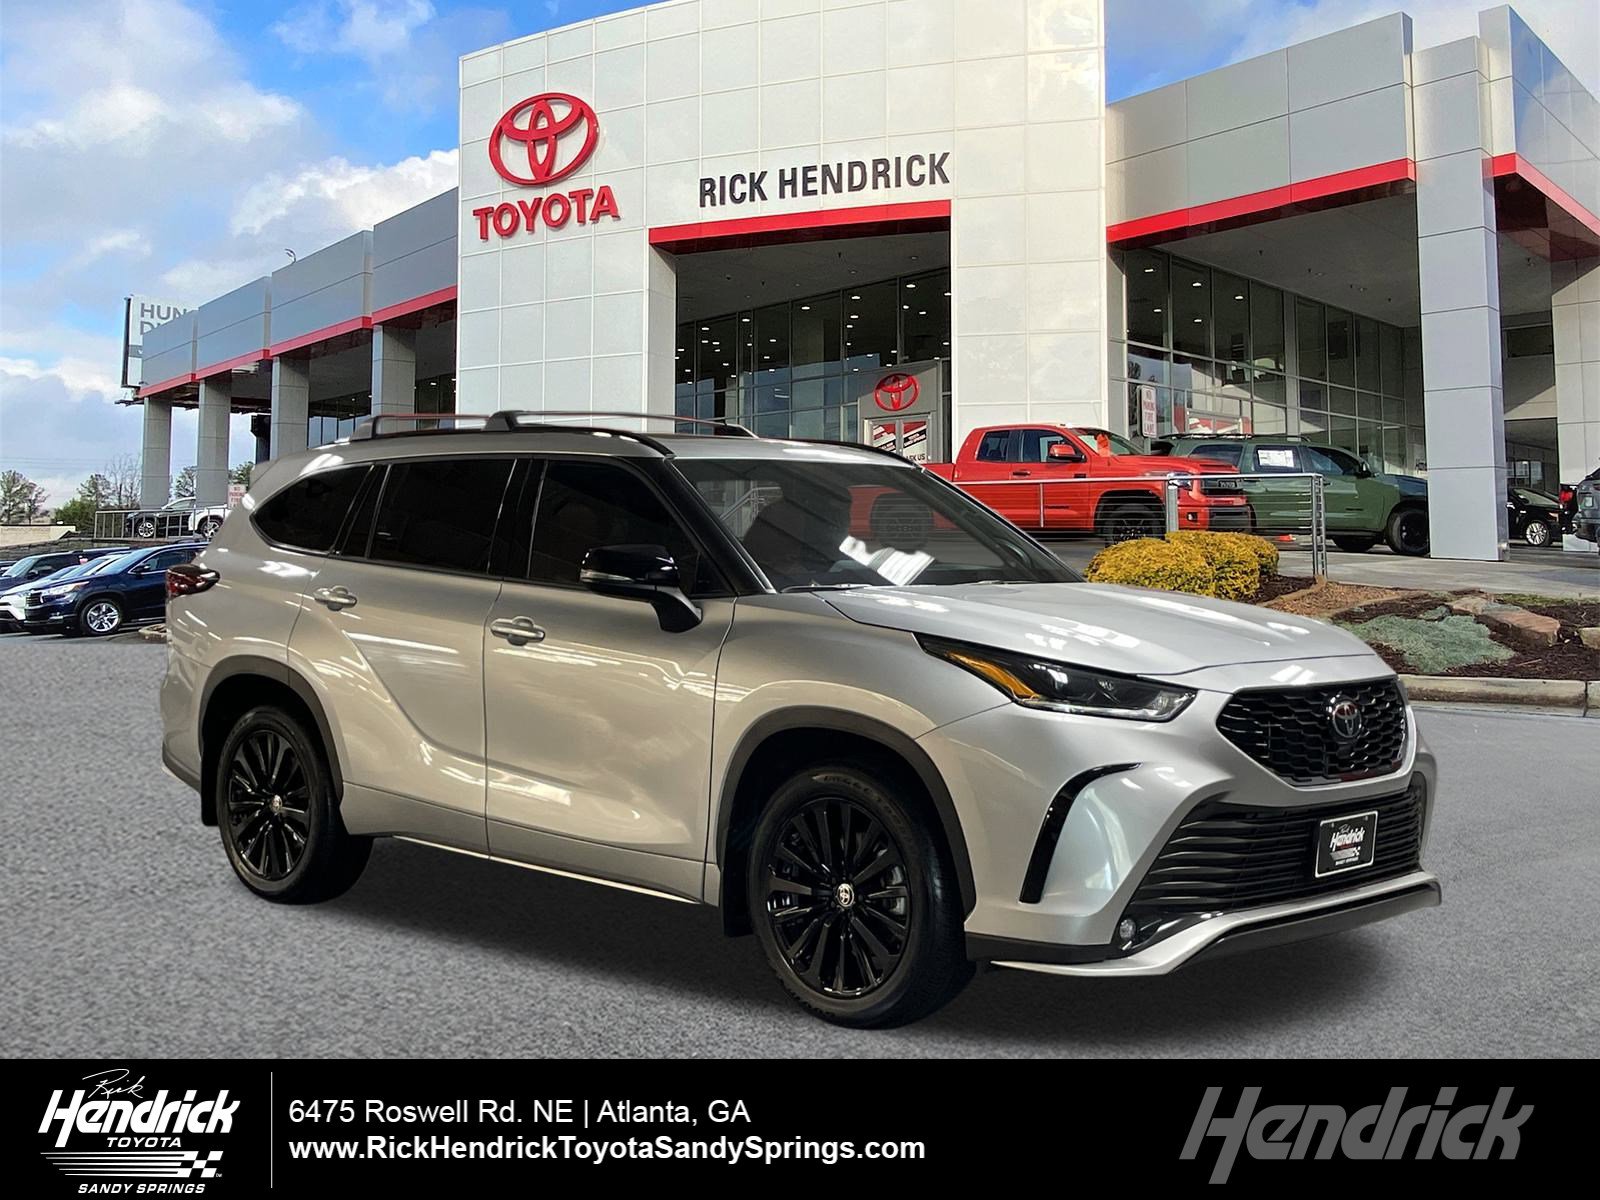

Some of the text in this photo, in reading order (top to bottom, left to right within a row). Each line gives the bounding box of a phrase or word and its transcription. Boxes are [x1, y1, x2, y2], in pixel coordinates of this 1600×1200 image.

[699, 152, 950, 208] RICK HENDRICK
[472, 186, 618, 240] TOYOTA
[1329, 827, 1366, 852] Hendrick
